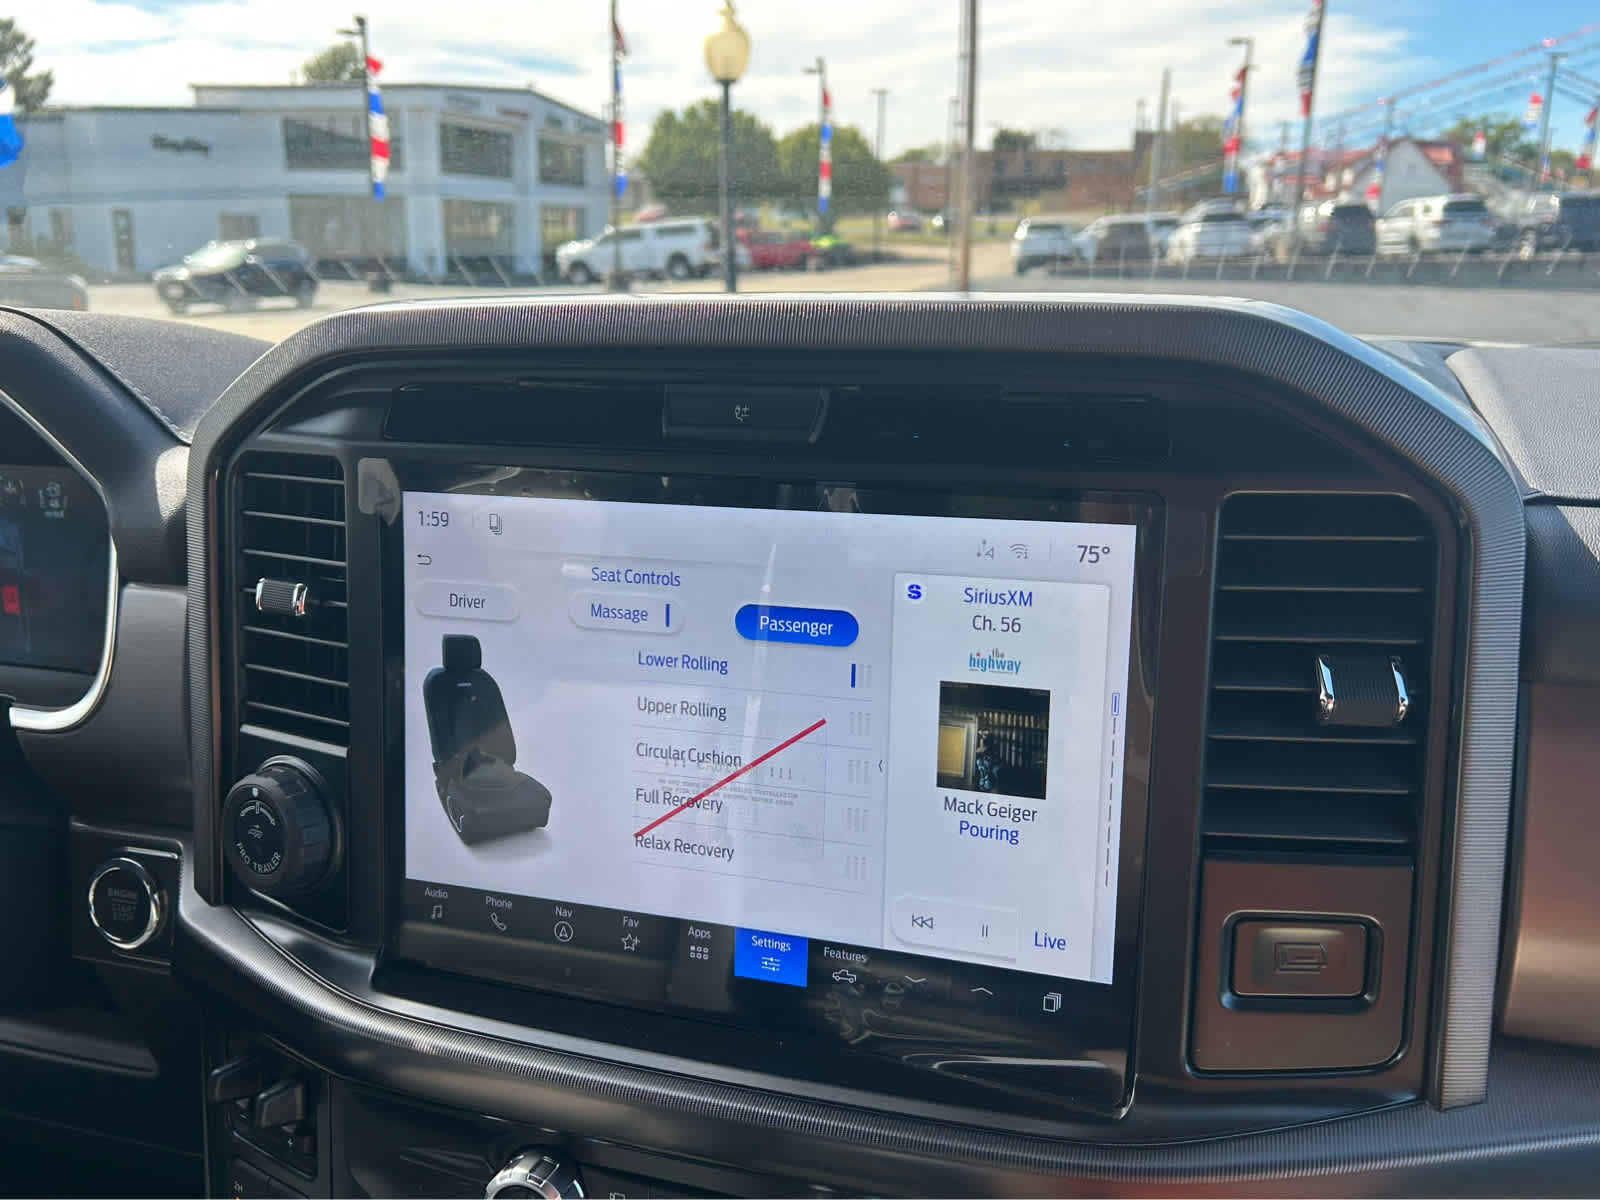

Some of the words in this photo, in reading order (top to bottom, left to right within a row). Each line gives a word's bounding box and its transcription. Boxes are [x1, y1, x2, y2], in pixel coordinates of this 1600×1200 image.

[418, 510, 449, 527] 1:59
[1077, 545, 1110, 563] 75°
[591, 567, 621, 582] Seat
[624, 569, 681, 586] Controls
[449, 593, 486, 609] Driver
[964, 587, 1033, 607] SiriusXM
[590, 603, 648, 623] Massage
[759, 616, 834, 637] Passenger
[972, 615, 997, 631] Ch.
[1000, 617, 1022, 633] 56
[638, 651, 678, 668] Lower
[681, 655, 728, 675] Rolling
[969, 652, 1022, 674] highway
[637, 697, 677, 716] Upper
[680, 701, 727, 722] Rolling
[636, 742, 686, 761] Circular
[687, 748, 742, 767] Cushion
[635, 787, 660, 804] Full
[663, 792, 723, 814] Recovery
[943, 796, 983, 815] Mack
[987, 802, 1038, 823] Geiger
[959, 820, 1019, 845] Pouring
[634, 834, 671, 852] Relax
[674, 838, 734, 862] Recovery
[252, 852, 281, 873] TRAILER
[424, 888, 449, 899] Audio
[485, 895, 513, 910] Phone
[555, 905, 573, 918] Nav
[622, 916, 639, 928] Fav
[688, 926, 712, 940] Apps
[1034, 931, 1067, 950] Live
[751, 935, 791, 952] Settings
[823, 946, 867, 963] Features
